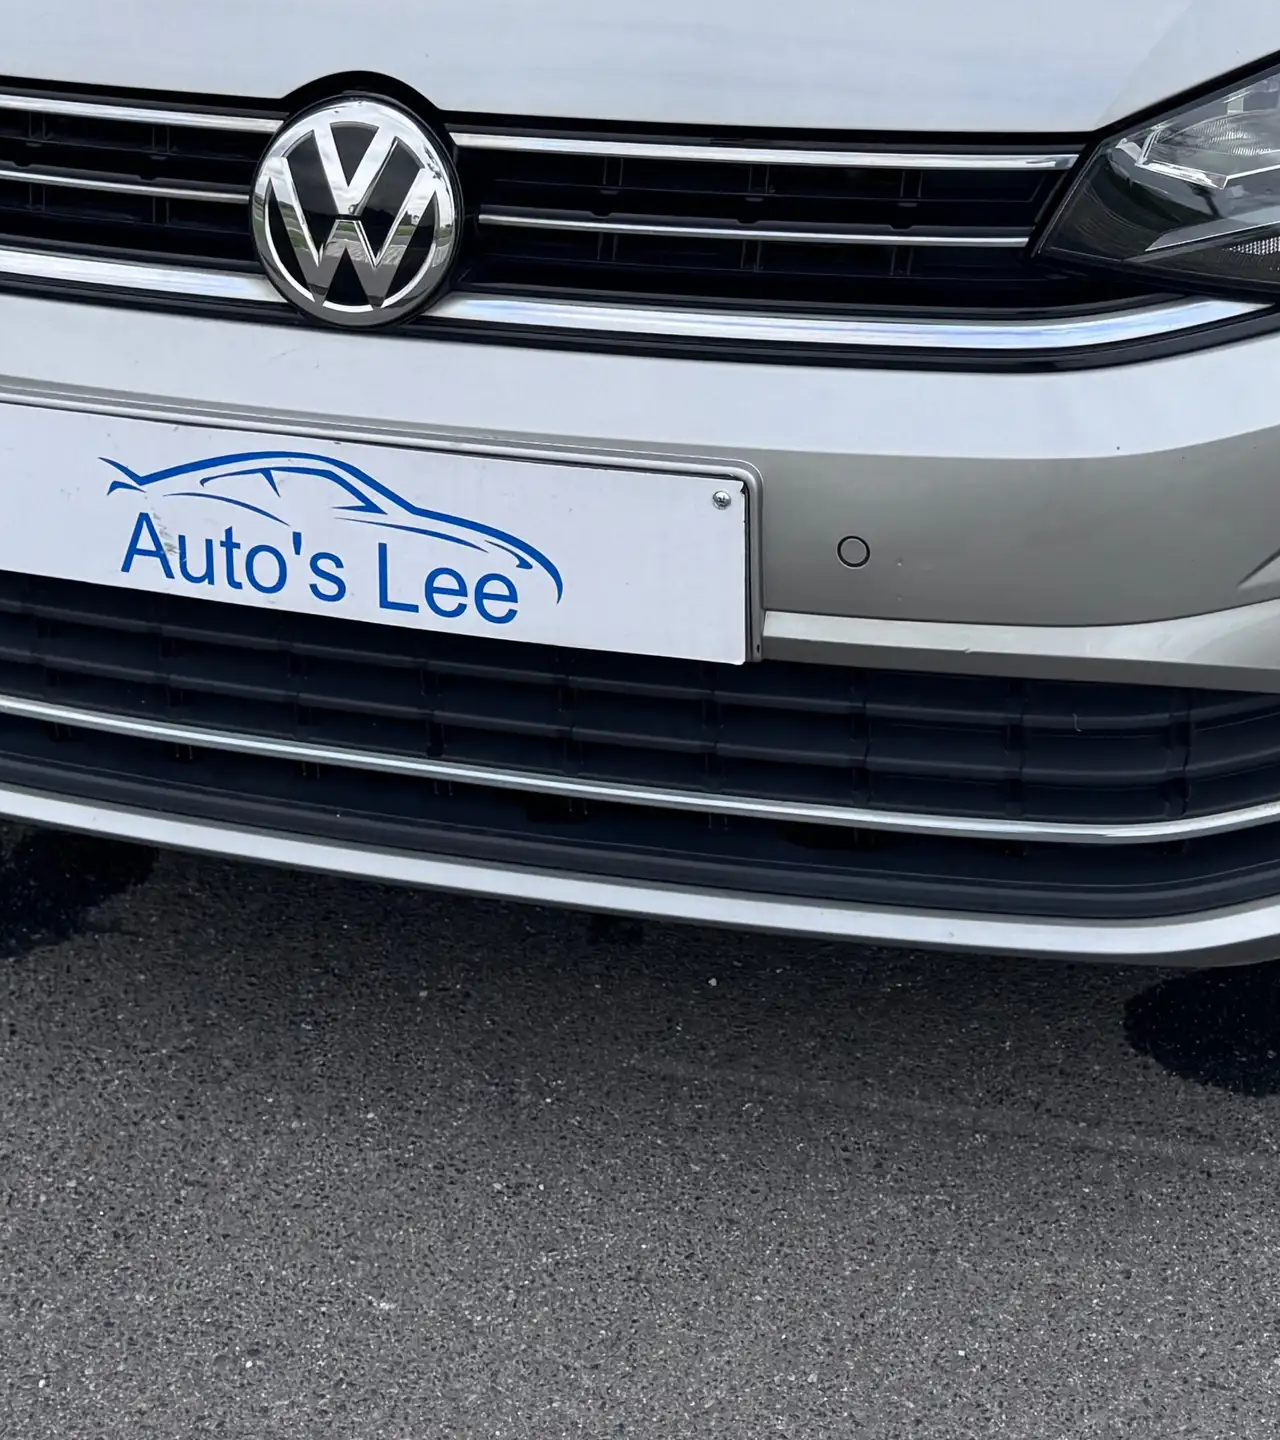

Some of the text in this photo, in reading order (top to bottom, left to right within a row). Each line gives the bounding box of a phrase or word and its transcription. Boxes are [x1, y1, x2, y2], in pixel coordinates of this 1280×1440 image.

[263, 112, 442, 314] VW
[121, 511, 521, 626] Auto's Lee
